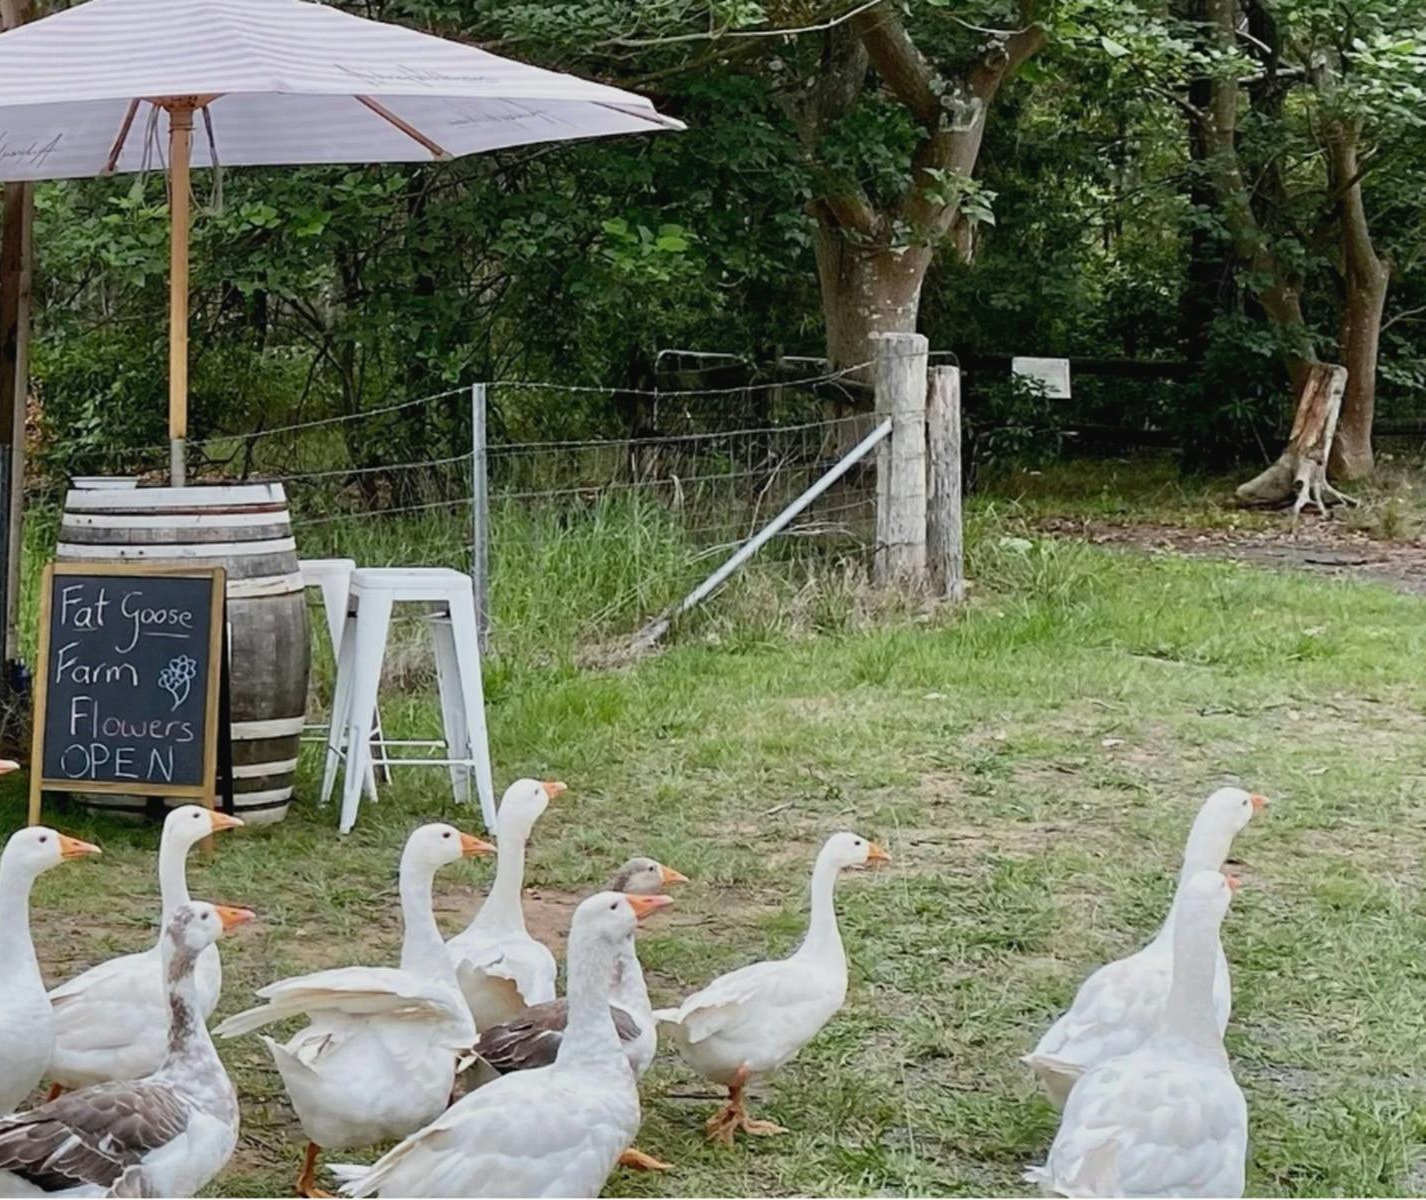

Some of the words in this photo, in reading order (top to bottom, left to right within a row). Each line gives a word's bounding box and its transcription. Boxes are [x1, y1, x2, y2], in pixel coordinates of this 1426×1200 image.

[61, 584, 110, 626] Fat
[115, 592, 193, 653] Goose
[56, 642, 138, 686] Farm
[71, 696, 194, 742] Flowers
[61, 743, 174, 782] OPEN
